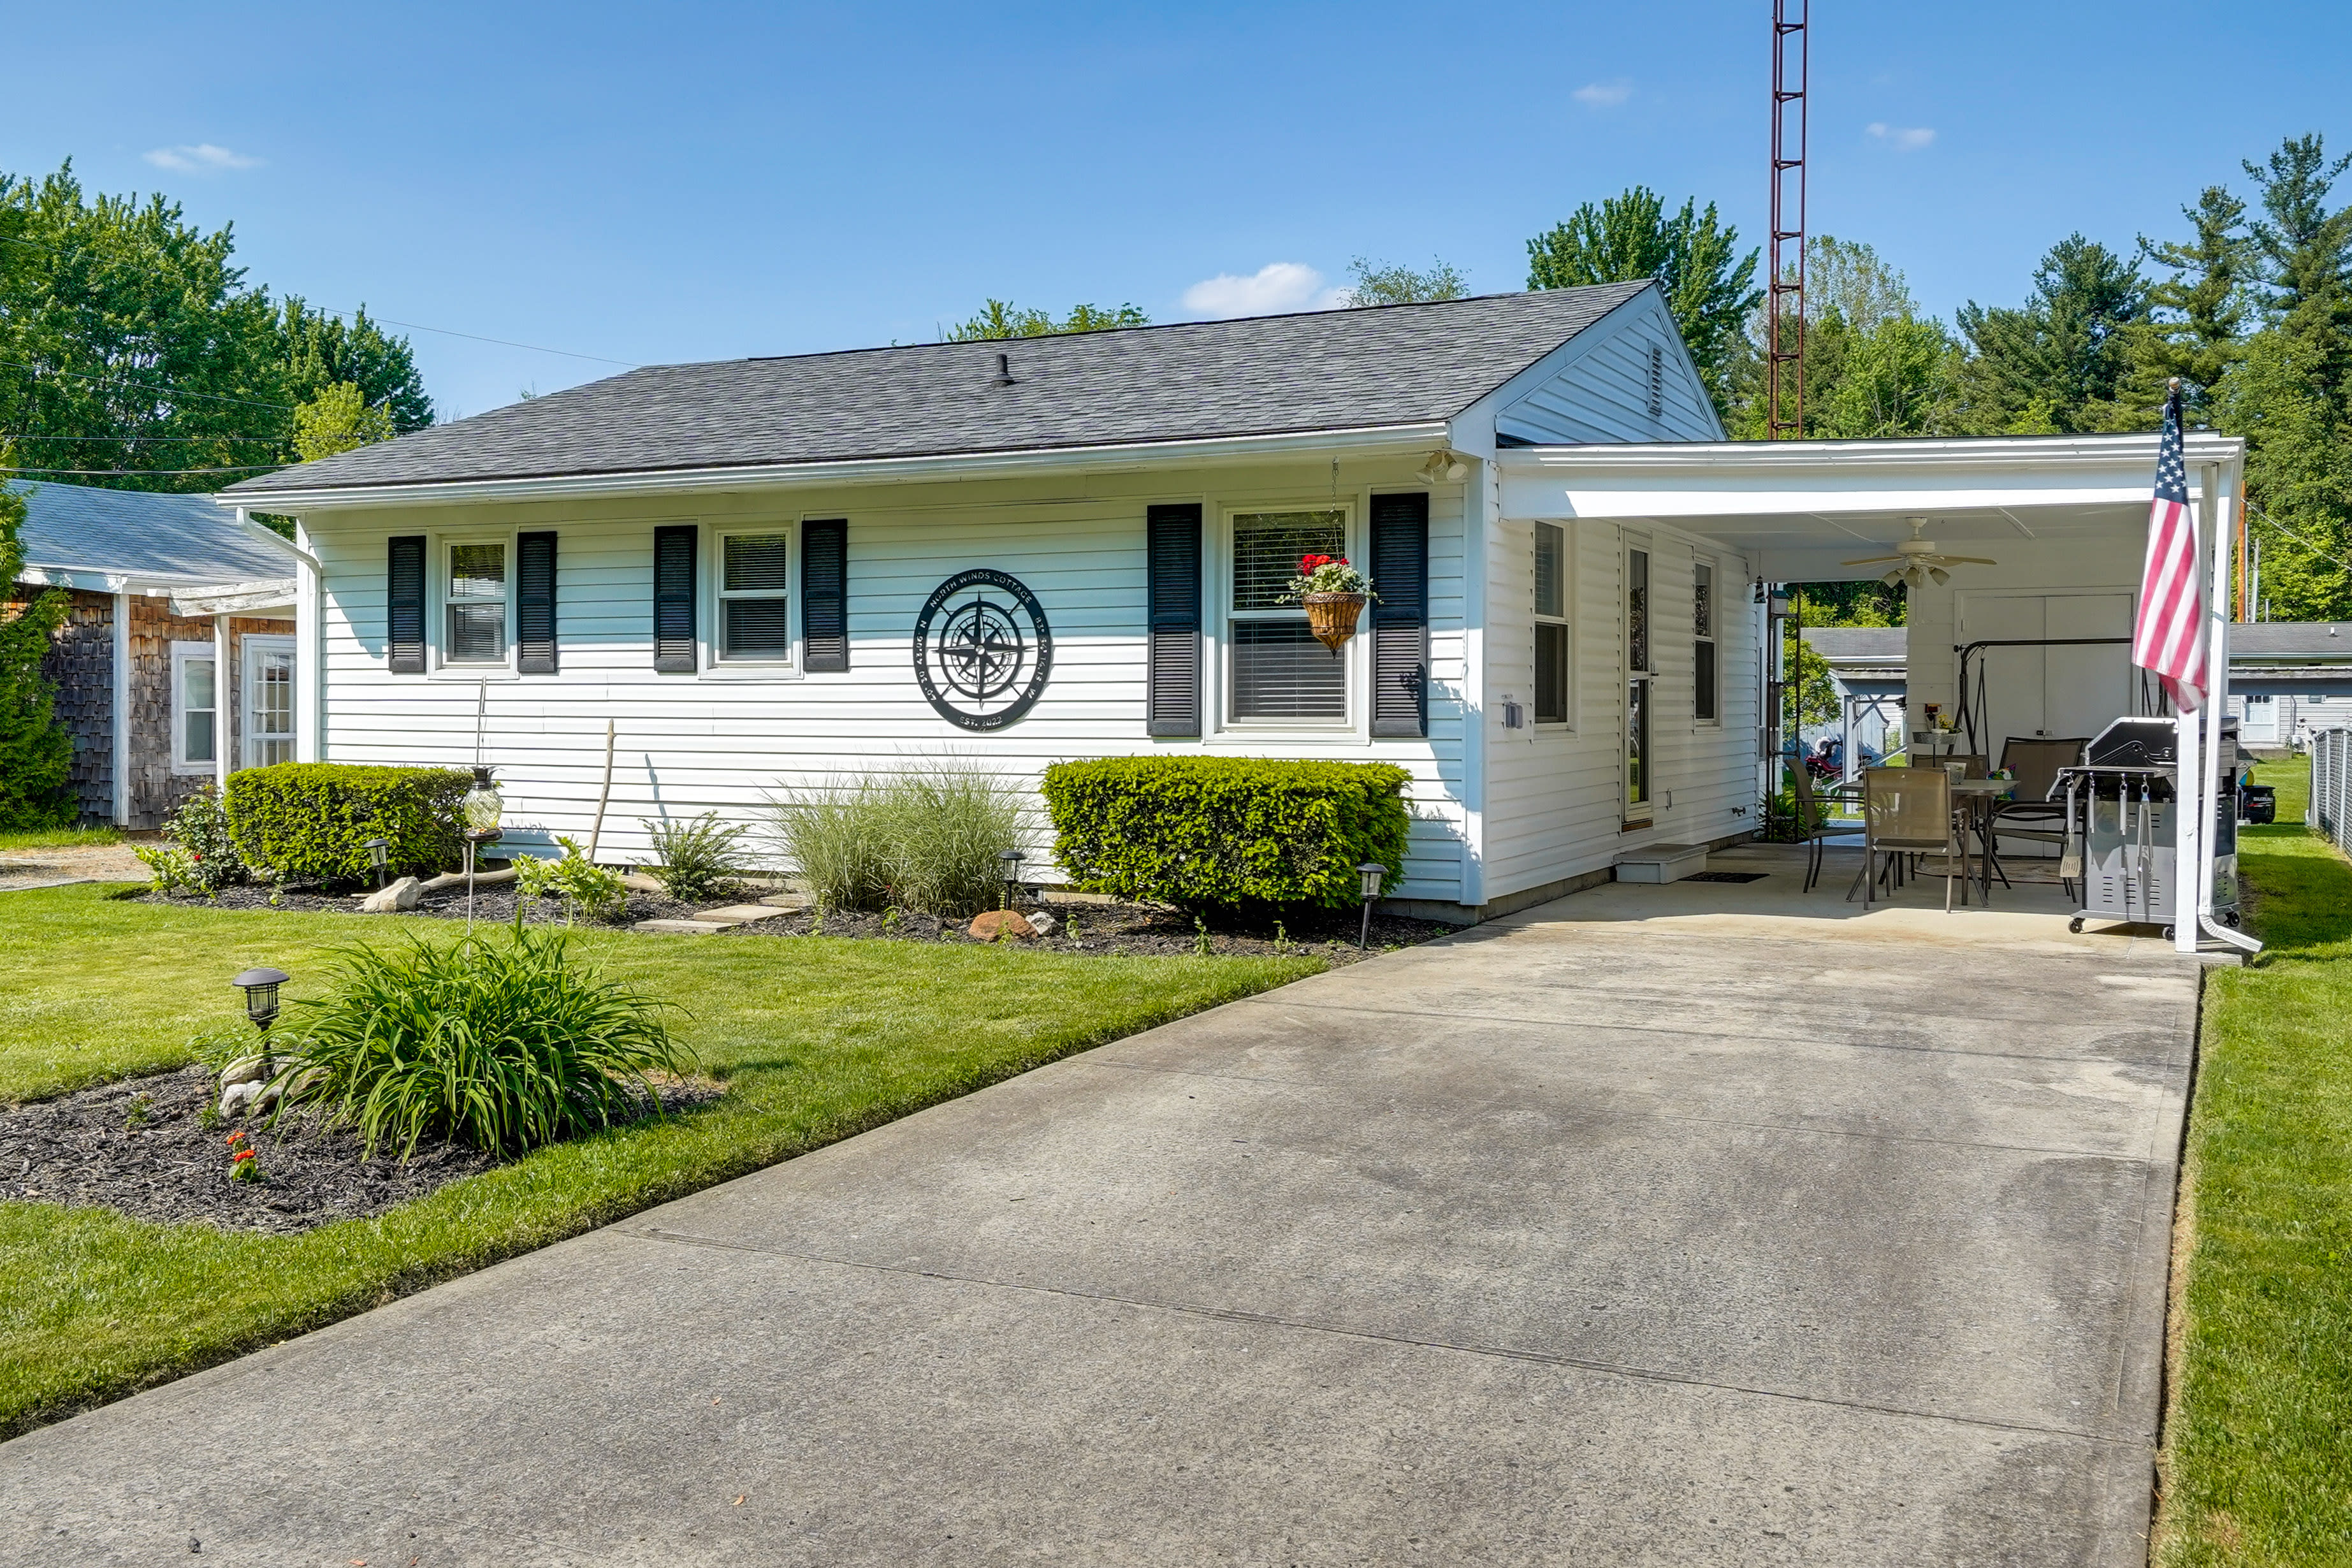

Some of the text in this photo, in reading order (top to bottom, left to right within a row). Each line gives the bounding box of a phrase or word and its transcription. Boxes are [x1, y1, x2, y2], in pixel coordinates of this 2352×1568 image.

[929, 572, 1033, 607] NORTH WINDS COTTAGE
[920, 620, 927, 628] N
[1027, 688, 1036, 699] W
[959, 716, 1003, 727] EST. 2022
